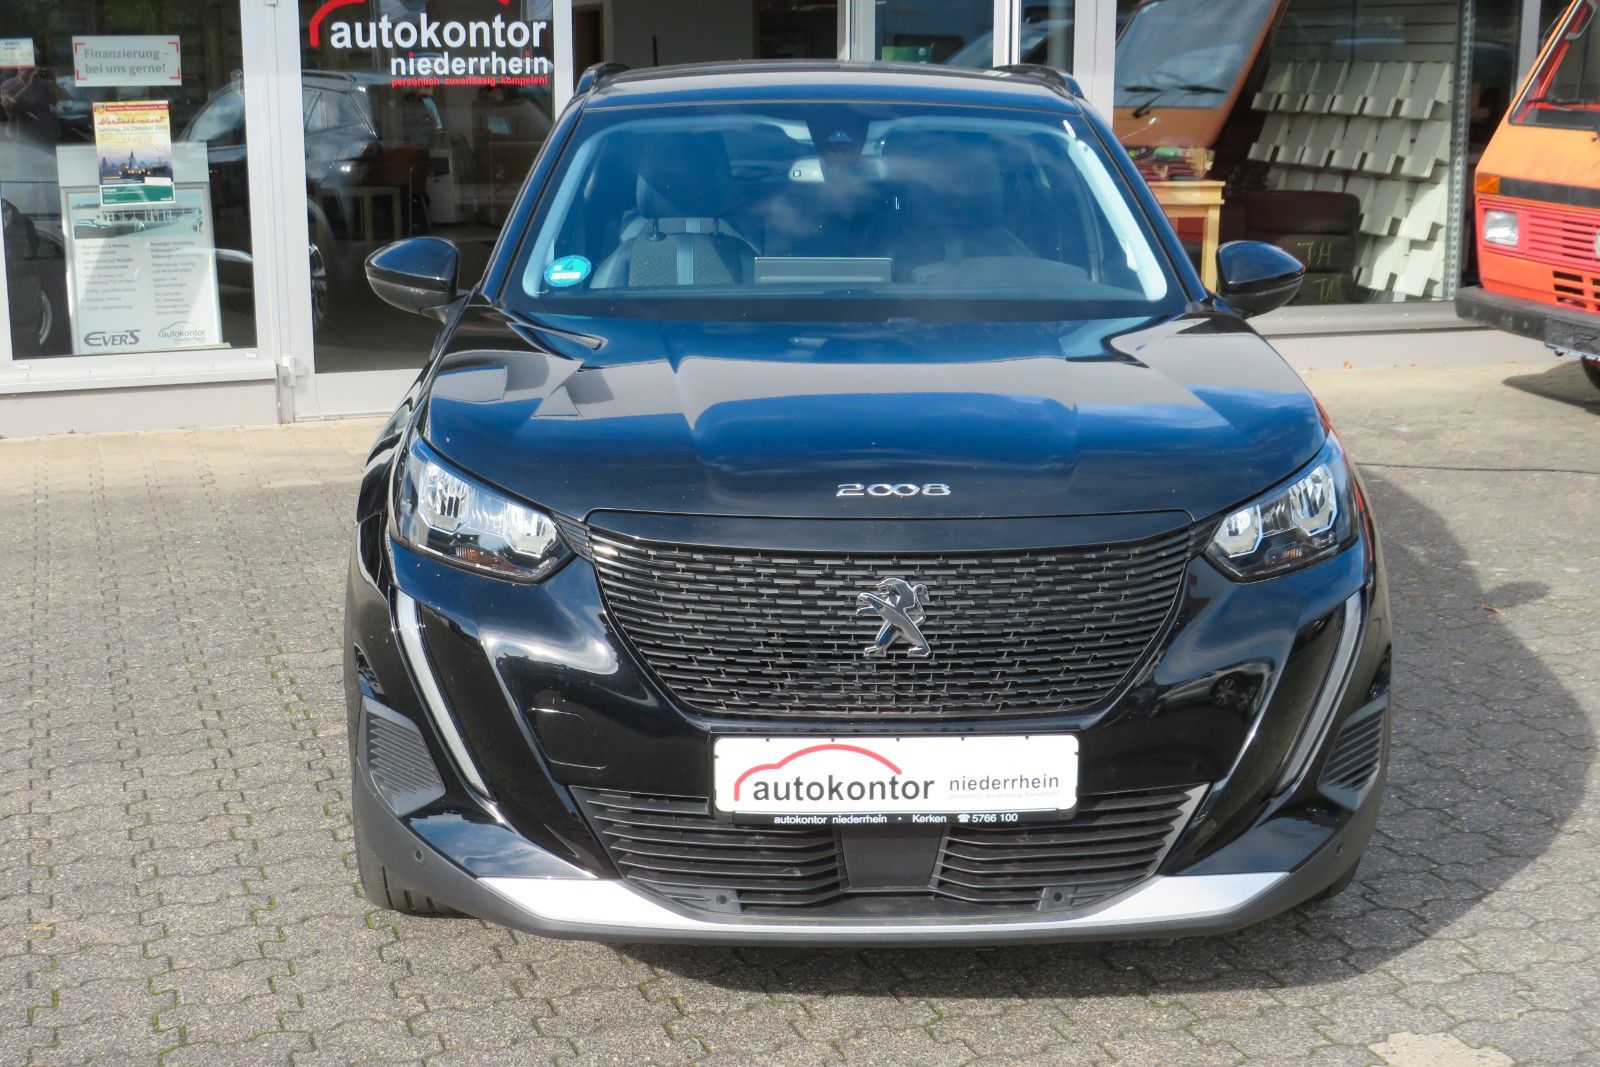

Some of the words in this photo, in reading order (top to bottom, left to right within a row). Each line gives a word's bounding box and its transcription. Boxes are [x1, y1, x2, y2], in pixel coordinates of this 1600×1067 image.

[330, 13, 547, 48] autokontor
[84, 48, 160, 60] Finanzierung
[391, 51, 548, 75] niederrhein
[85, 64, 102, 73] bei
[106, 65, 126, 73] uns
[129, 64, 166, 76] gerne!
[501, 75, 548, 86] kompetent
[162, 329, 205, 338] autokontor
[836, 483, 951, 497] 2008
[753, 775, 935, 801] autokontor
[949, 774, 1060, 791] niederrhein
[774, 814, 827, 824] autokontor
[832, 813, 887, 824] niederrhein
[912, 813, 947, 823] Kerken
[972, 813, 996, 823] 5766
[1000, 812, 1018, 822] 100
